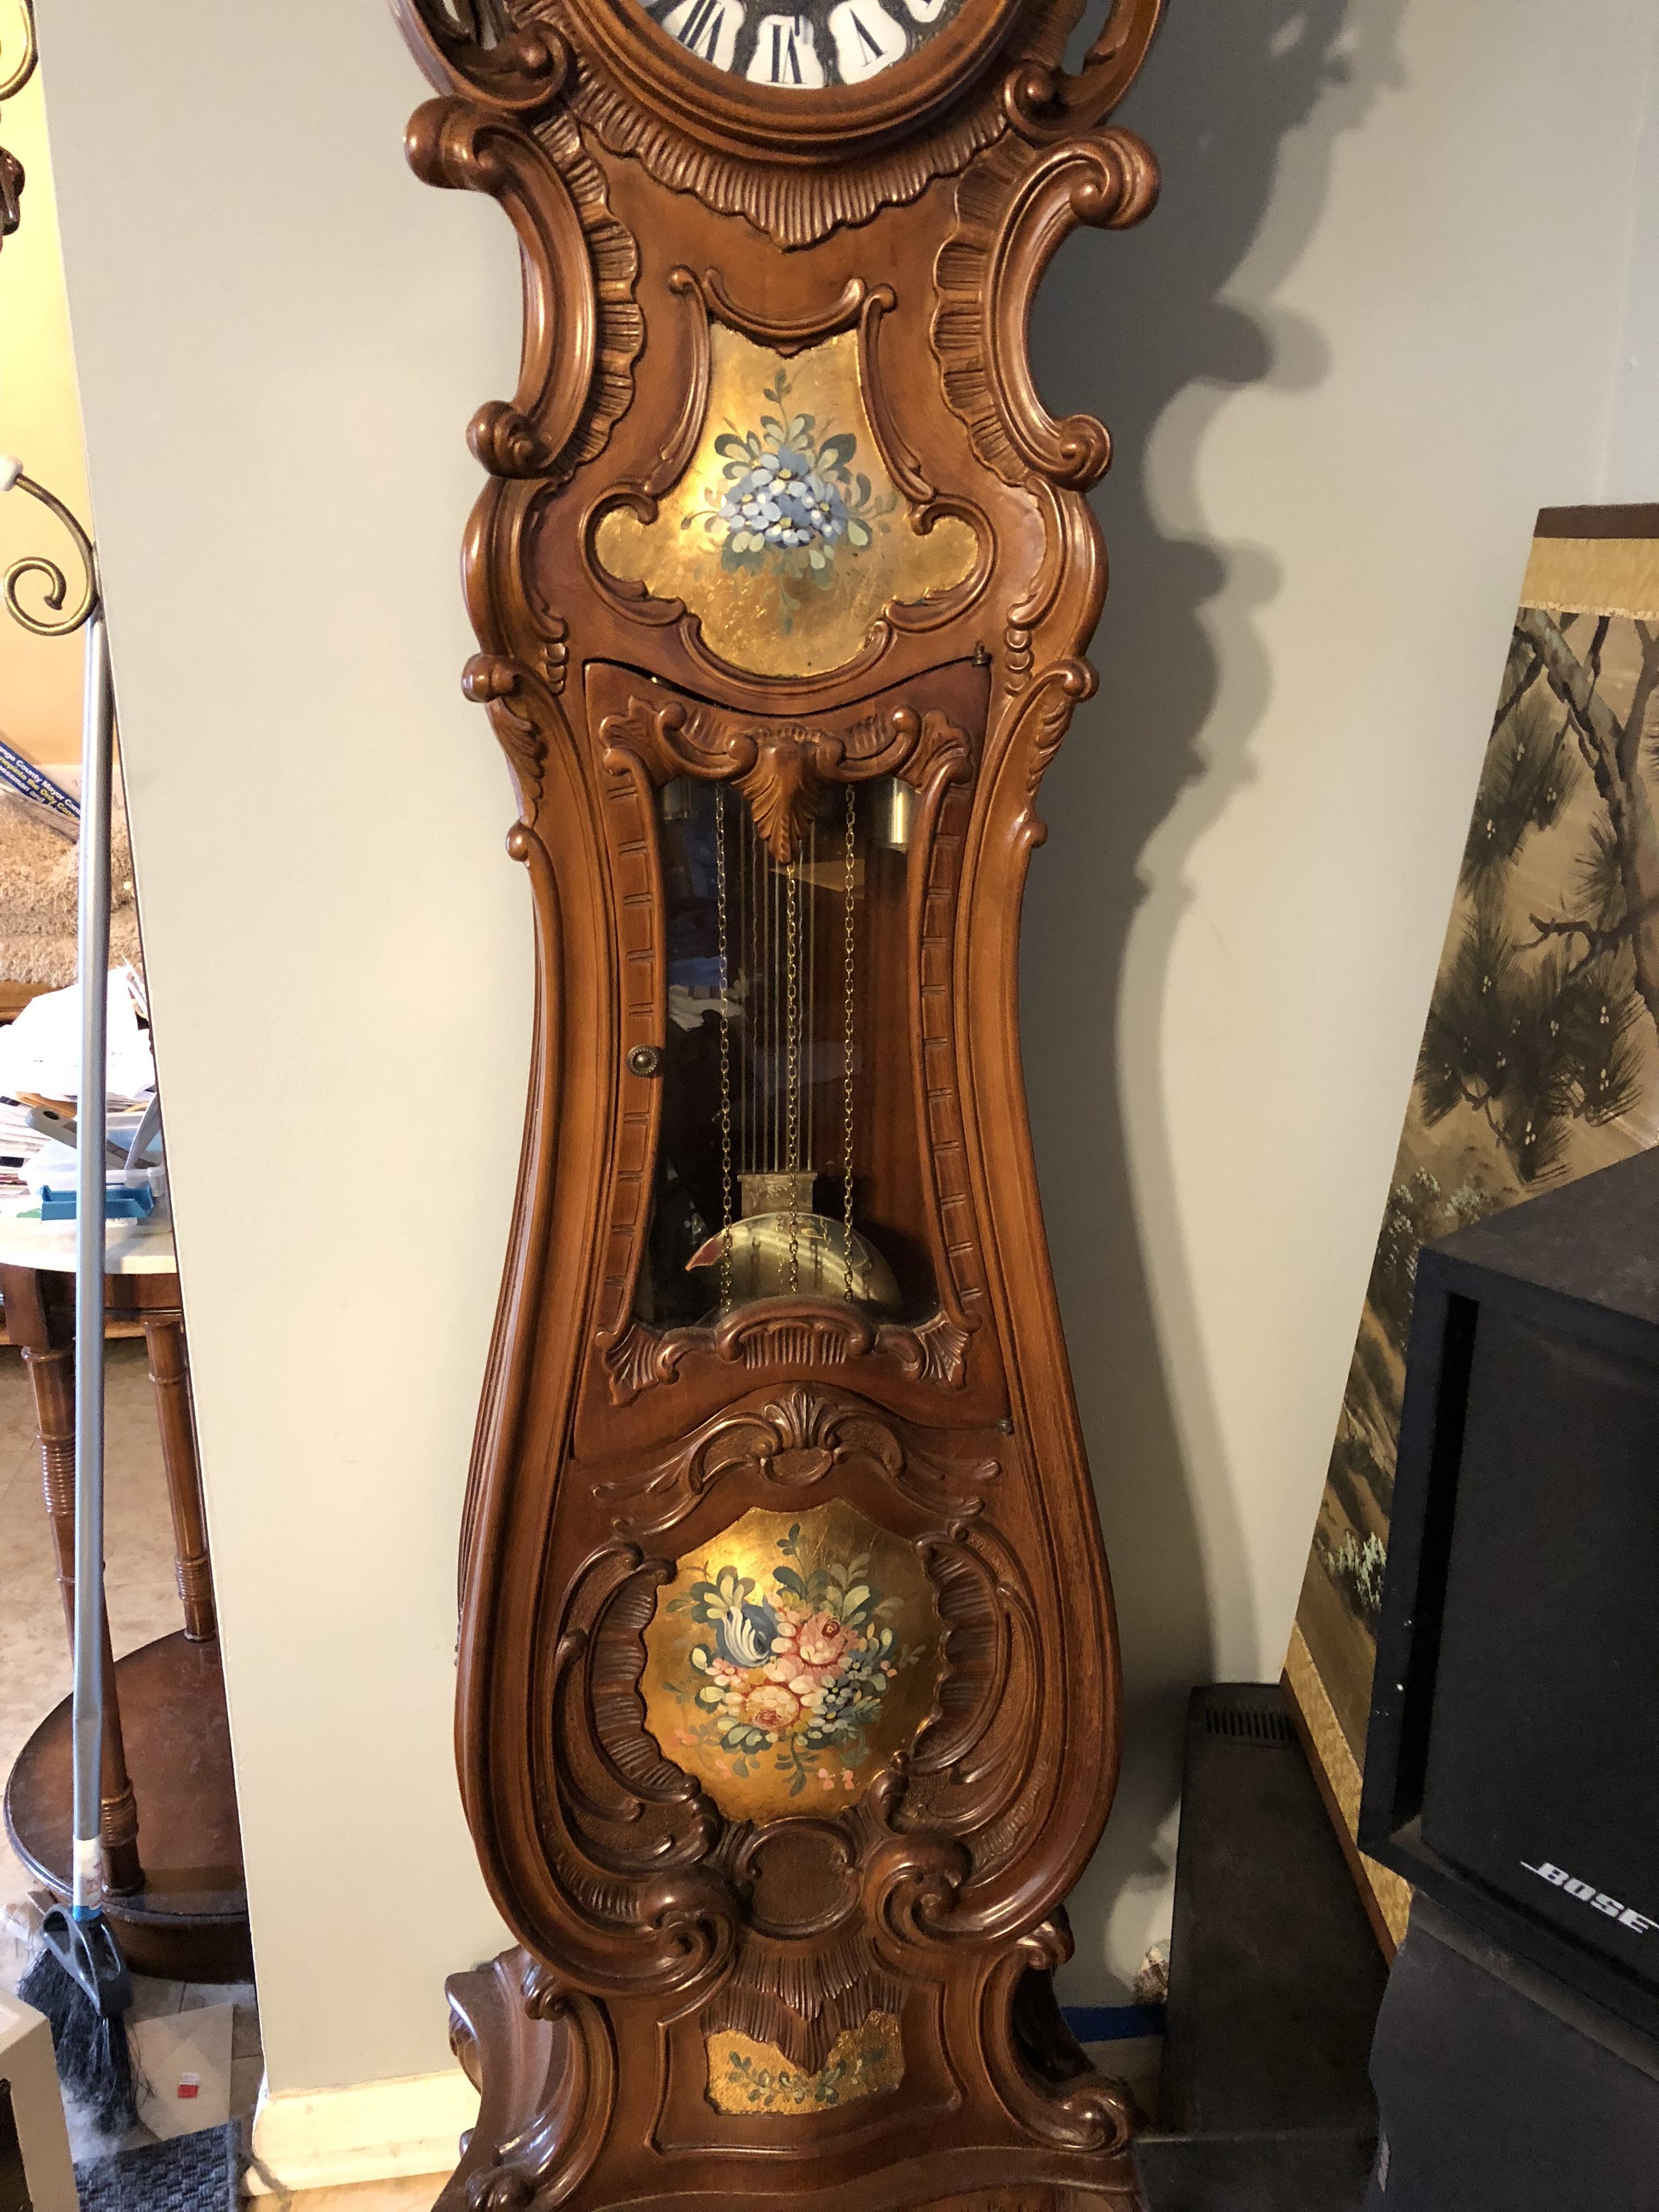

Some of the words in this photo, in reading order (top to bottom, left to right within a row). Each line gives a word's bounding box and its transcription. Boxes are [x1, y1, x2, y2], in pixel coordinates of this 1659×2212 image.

[16, 760, 42, 783] County
[42, 781, 65, 800] Mayor
[27, 778, 40, 790] the
[40, 789, 57, 805] Only
[1519, 1860, 1659, 1934] BOSE
